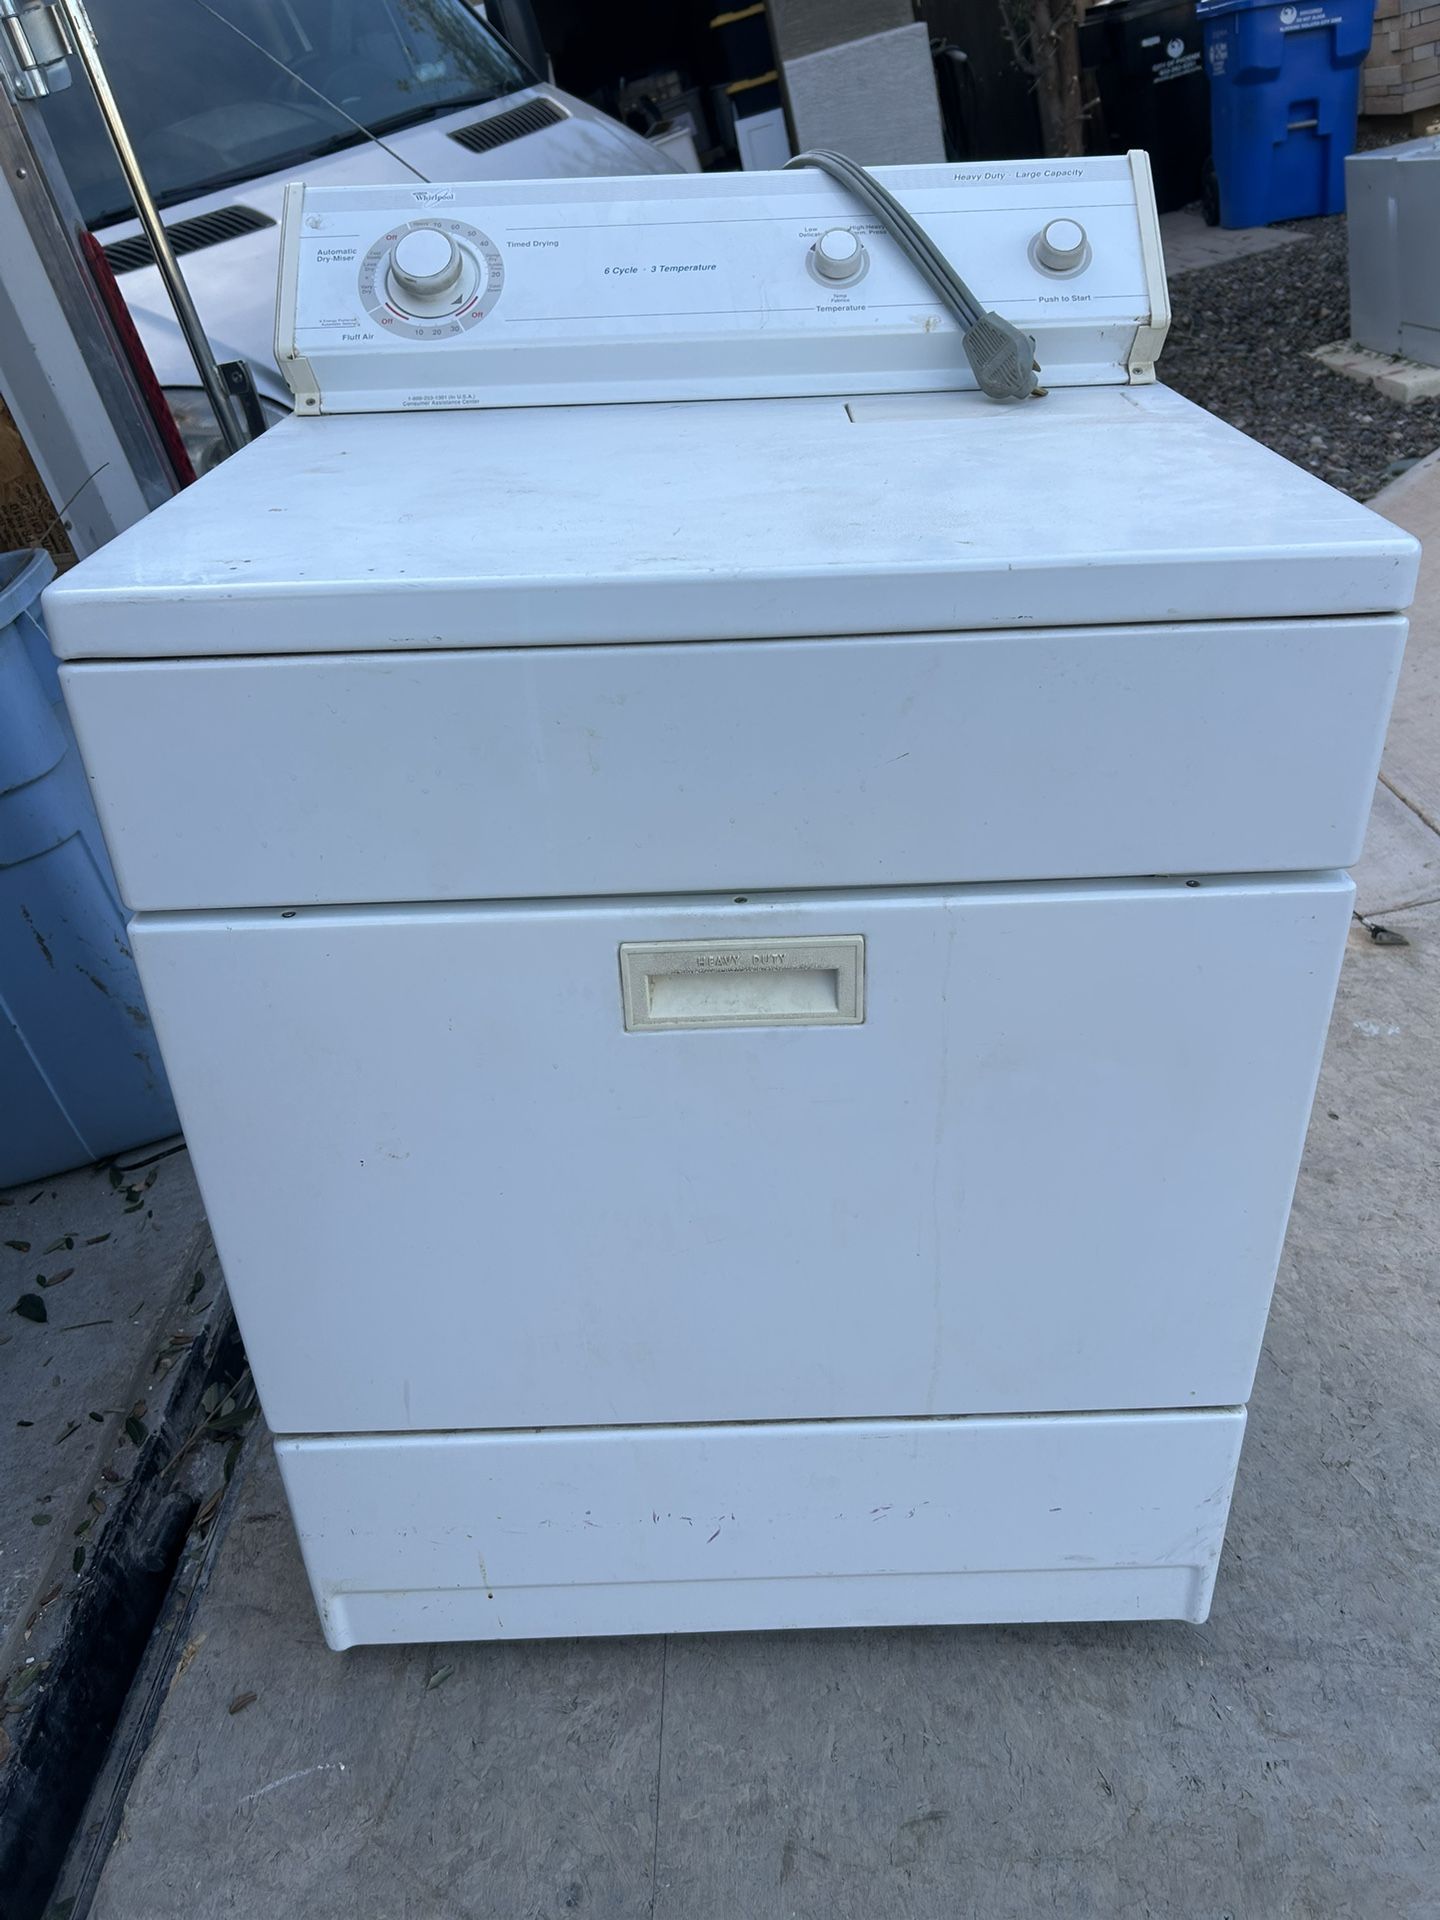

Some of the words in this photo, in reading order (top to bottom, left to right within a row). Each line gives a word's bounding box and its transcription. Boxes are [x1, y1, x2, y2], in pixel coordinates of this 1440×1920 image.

[954, 173, 981, 181] Heavy
[985, 172, 1006, 180] Duty
[1044, 169, 1083, 177] Capacity
[416, 192, 454, 202] Whirlpool
[506, 240, 531, 248] Timed
[533, 240, 559, 248] Drying
[317, 255, 355, 263] Dry-Miser
[612, 266, 638, 275] Cycle
[651, 265, 657, 273] 3
[660, 264, 717, 273] Temperature
[1071, 294, 1091, 302] Start
[816, 305, 866, 313] Temperature
[696, 955, 740, 967] HEAVY
[752, 953, 786, 965] DUTY
